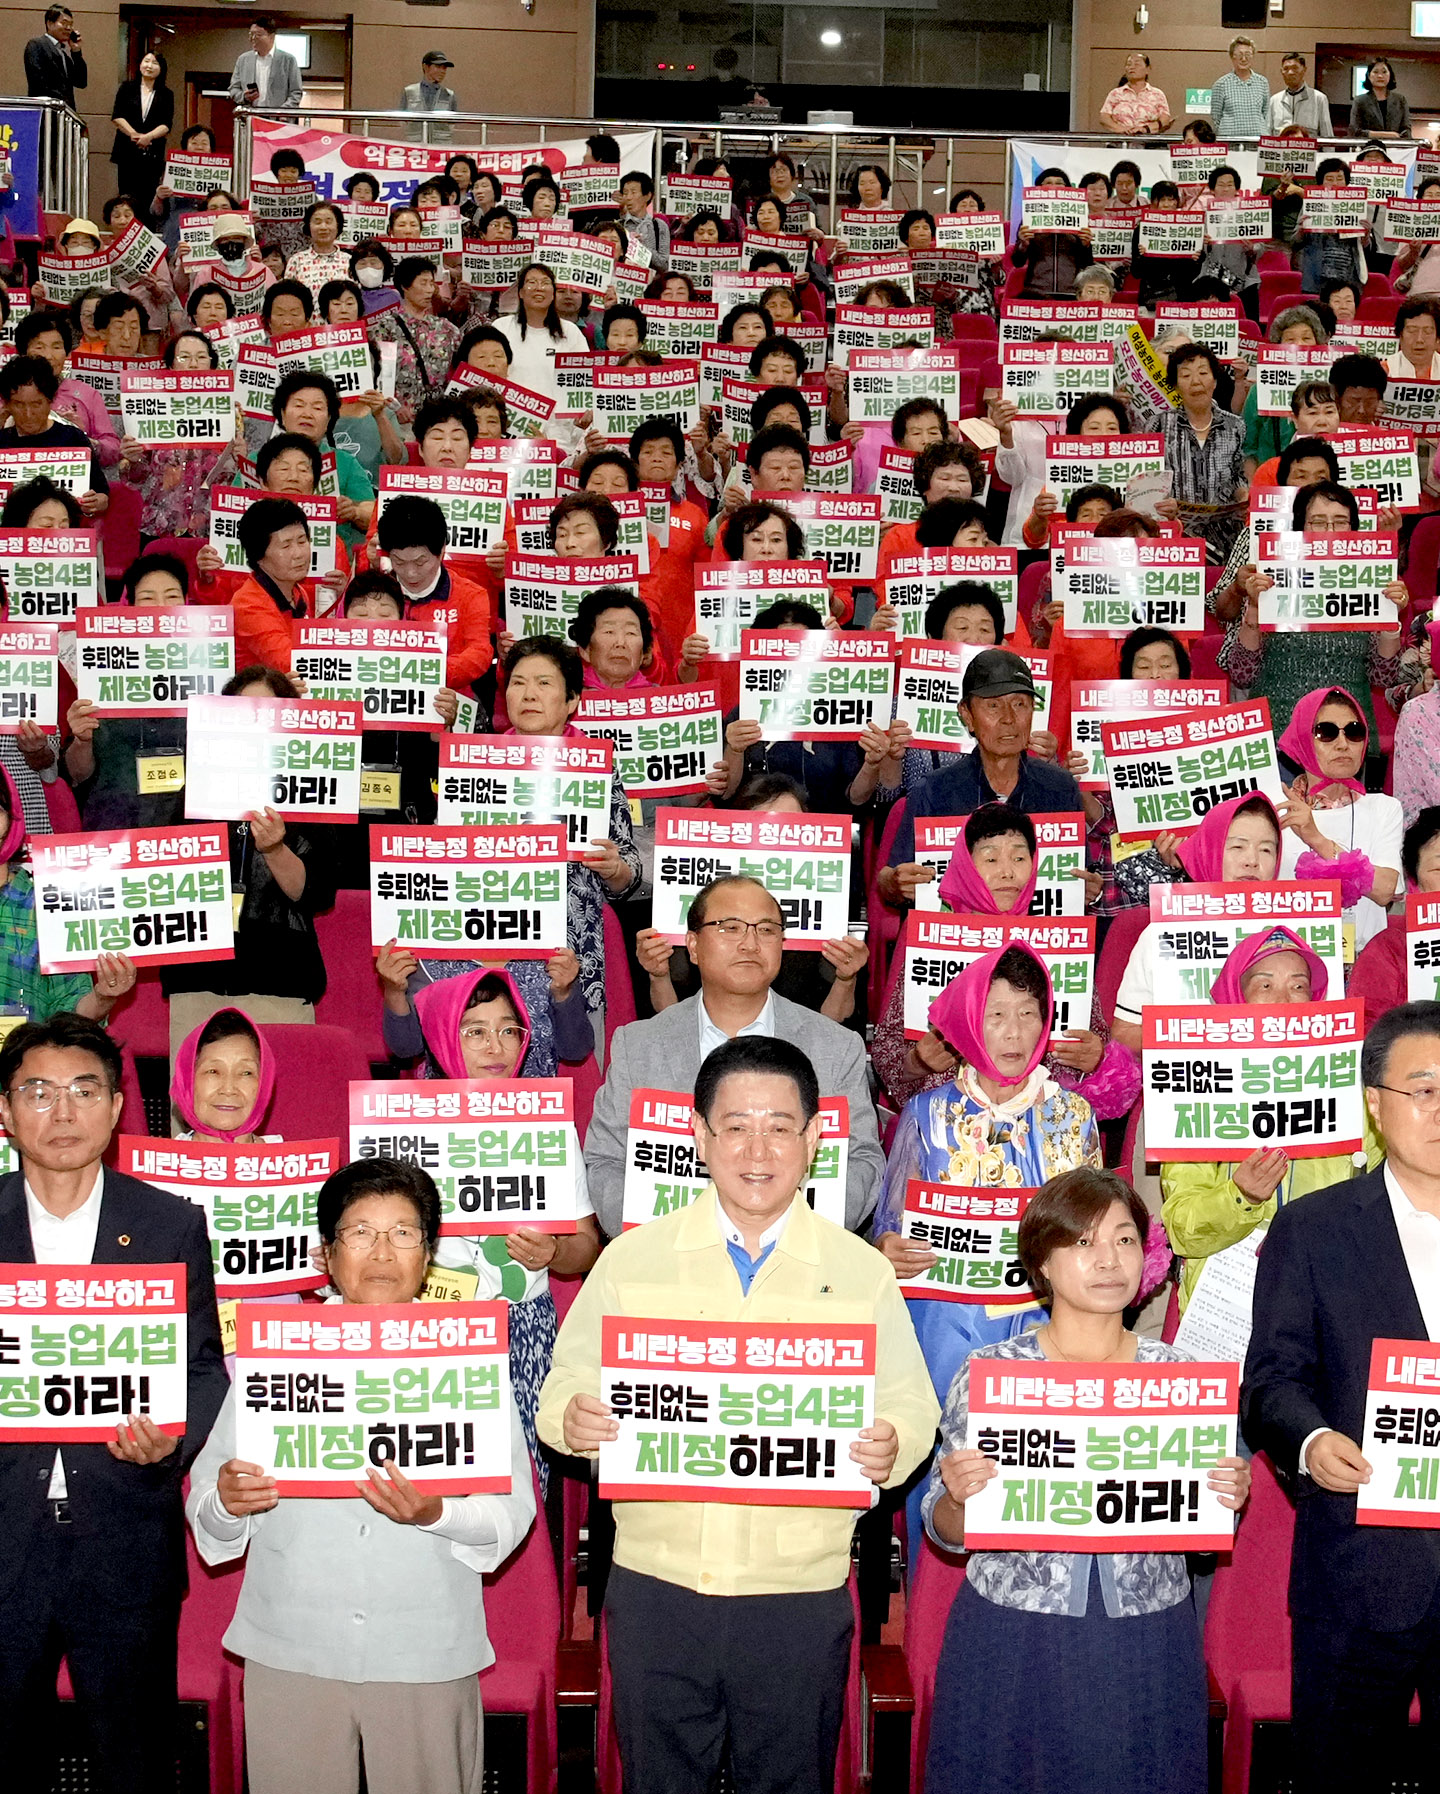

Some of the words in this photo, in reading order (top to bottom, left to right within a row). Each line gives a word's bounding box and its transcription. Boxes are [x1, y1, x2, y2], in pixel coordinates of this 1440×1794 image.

[1189, 94, 1212, 104] AED
[363, 145, 428, 169] 억울한
[436, 150, 545, 171] 피해자
[1031, 214, 1081, 227] 제정하라!
[1051, 201, 1087, 215] 농업4법
[1131, 331, 1156, 372] 여성농민도
[126, 376, 177, 390] 내란농정
[179, 376, 230, 390] 청산하고
[125, 398, 167, 416] 후퇴없는
[170, 396, 231, 416] 농업4법
[137, 418, 221, 439] 제정하라!
[361, 783, 392, 794] 김종숙
[381, 836, 467, 858] 내란농정
[473, 836, 560, 858] 청산하고
[377, 872, 449, 901] 후퇴없는
[455, 870, 560, 902] 농업4법
[397, 908, 541, 941] 제정하라!
[1155, 1016, 1254, 1042] 내란농정
[1261, 1014, 1357, 1041] 청산하고
[1150, 1060, 1234, 1095] 후퇴없는
[1241, 1053, 1358, 1093] 농업4법
[1174, 1099, 1337, 1141] 제정하라!
[617, 1333, 736, 1365] 내란농정
[745, 1336, 864, 1369] 청산하고
[610, 1381, 709, 1423] 후퇴없는
[718, 1383, 864, 1429] 농업4법
[636, 1433, 836, 1478] 제정하라!
